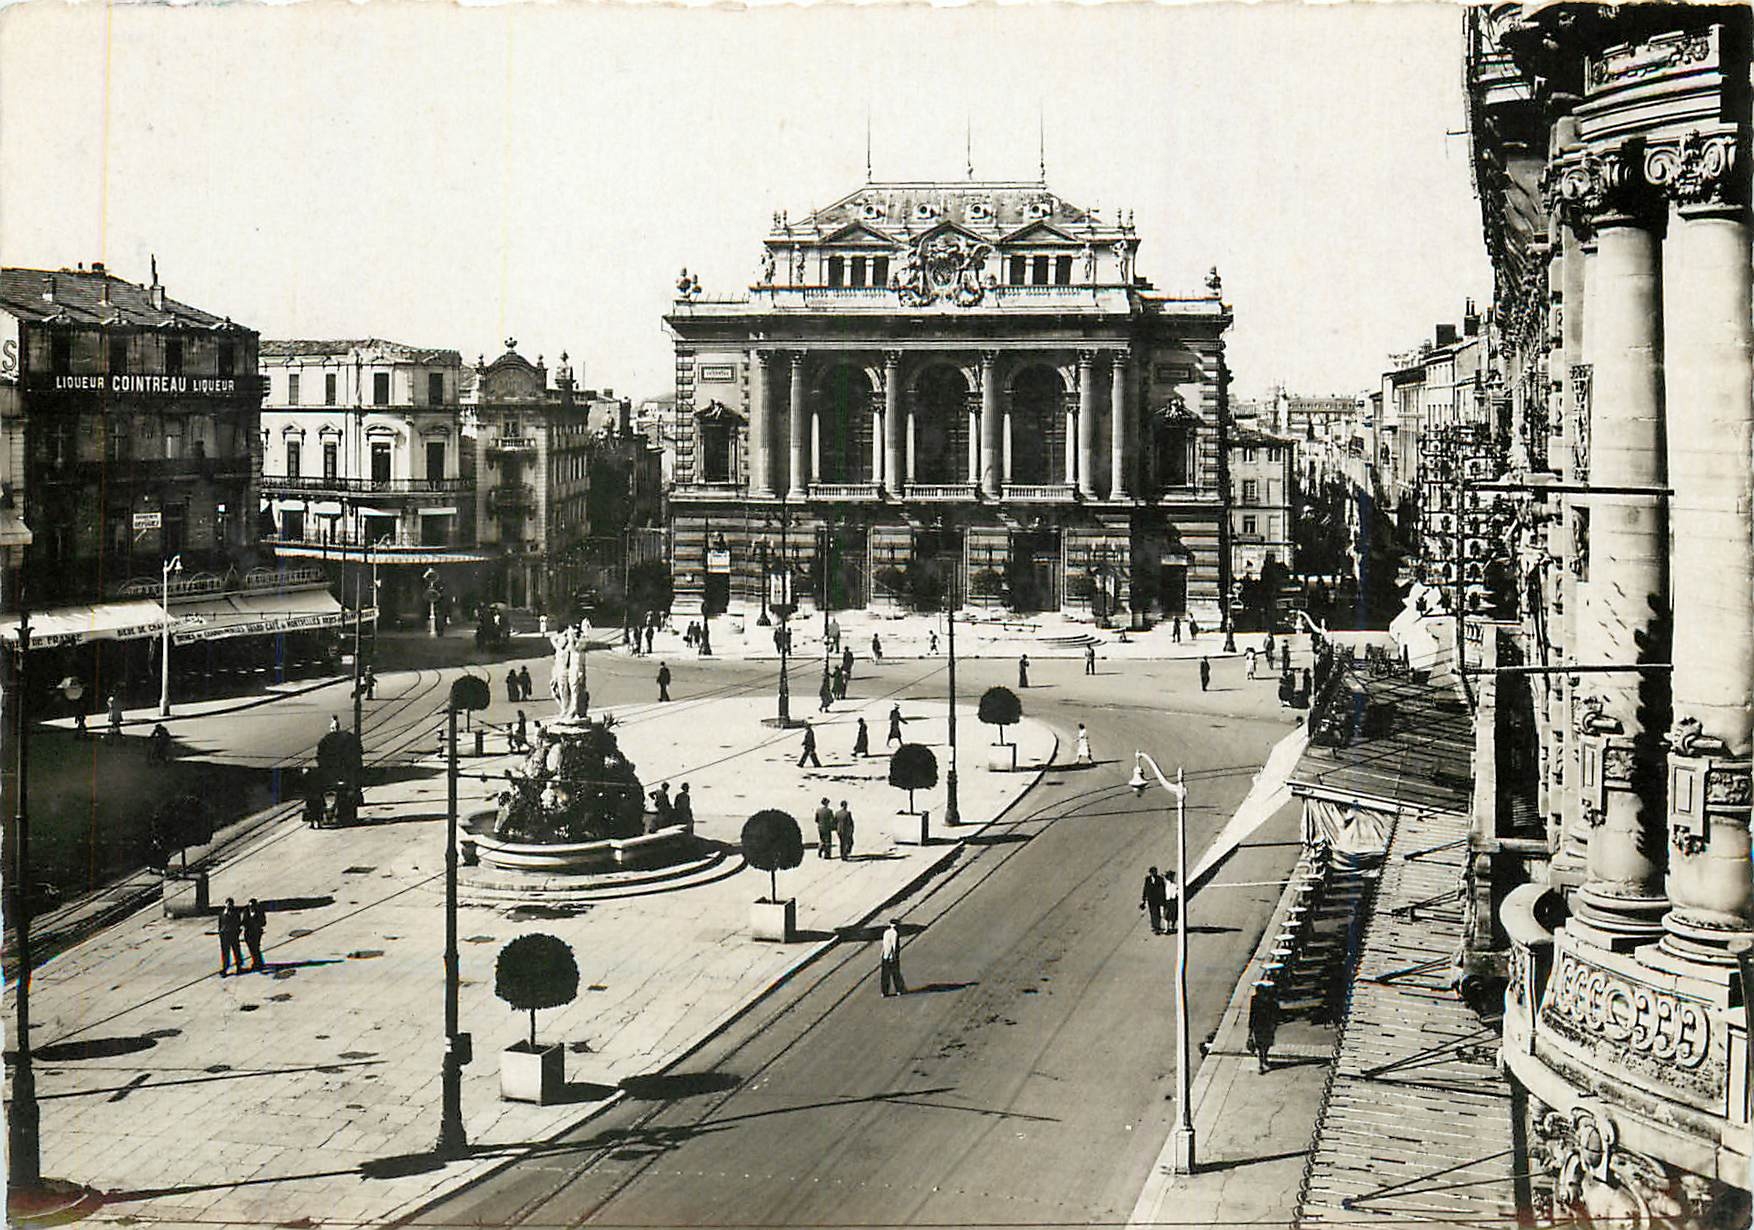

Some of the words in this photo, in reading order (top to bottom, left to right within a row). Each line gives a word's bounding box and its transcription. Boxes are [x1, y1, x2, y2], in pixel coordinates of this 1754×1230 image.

[55, 375, 105, 389] LIQUEUR
[112, 375, 187, 392] COINTREAU
[193, 379, 234, 391] LIQUEUR
